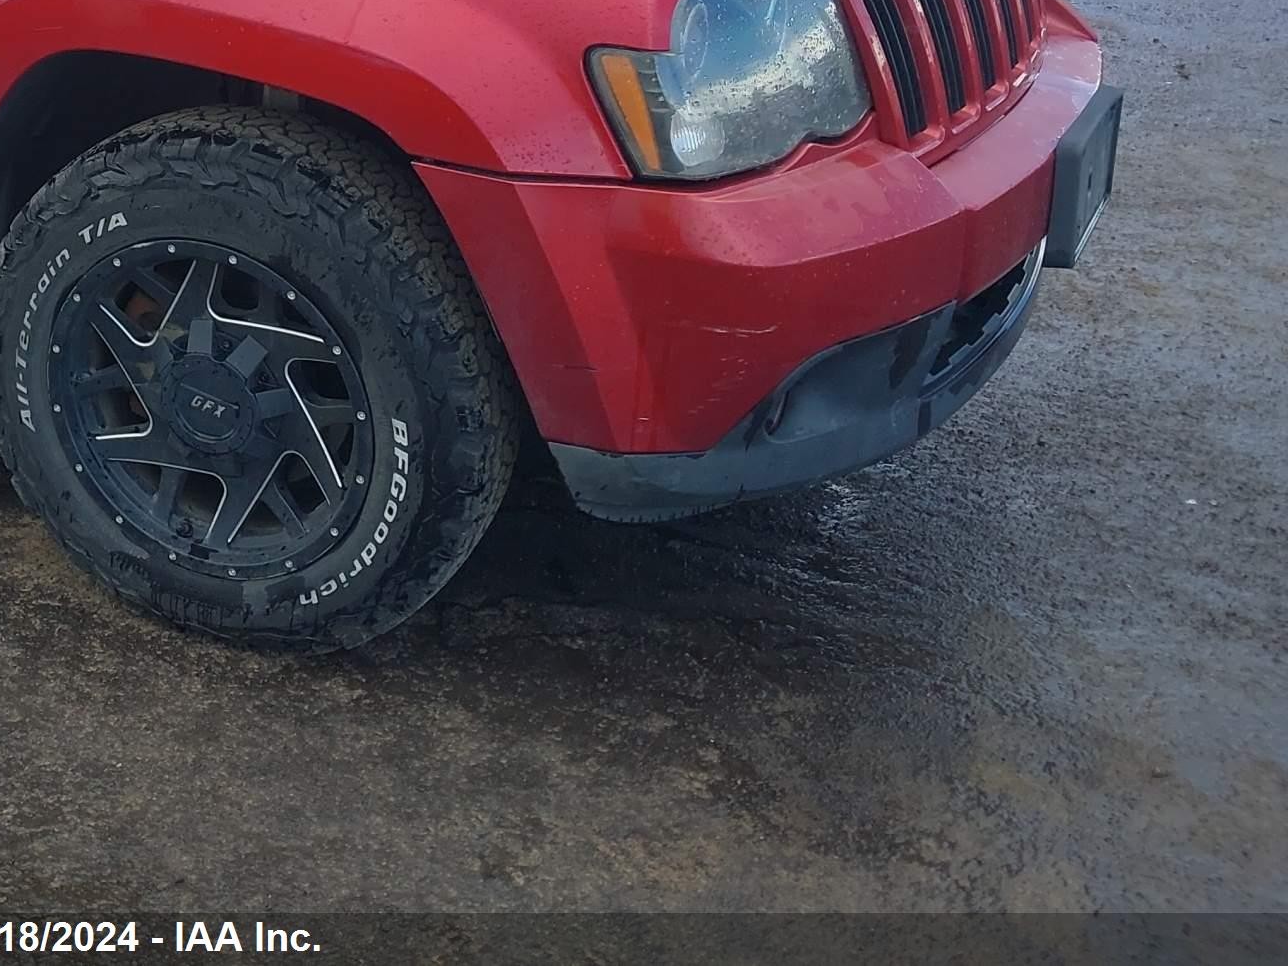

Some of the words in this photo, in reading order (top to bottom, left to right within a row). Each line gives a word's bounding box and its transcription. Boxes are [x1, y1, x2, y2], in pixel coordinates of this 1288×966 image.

[15, 248, 71, 433] All-Terrain
[78, 212, 128, 245] T/A
[191, 395, 226, 418] GFX
[299, 418, 409, 605] BFGoodrich
